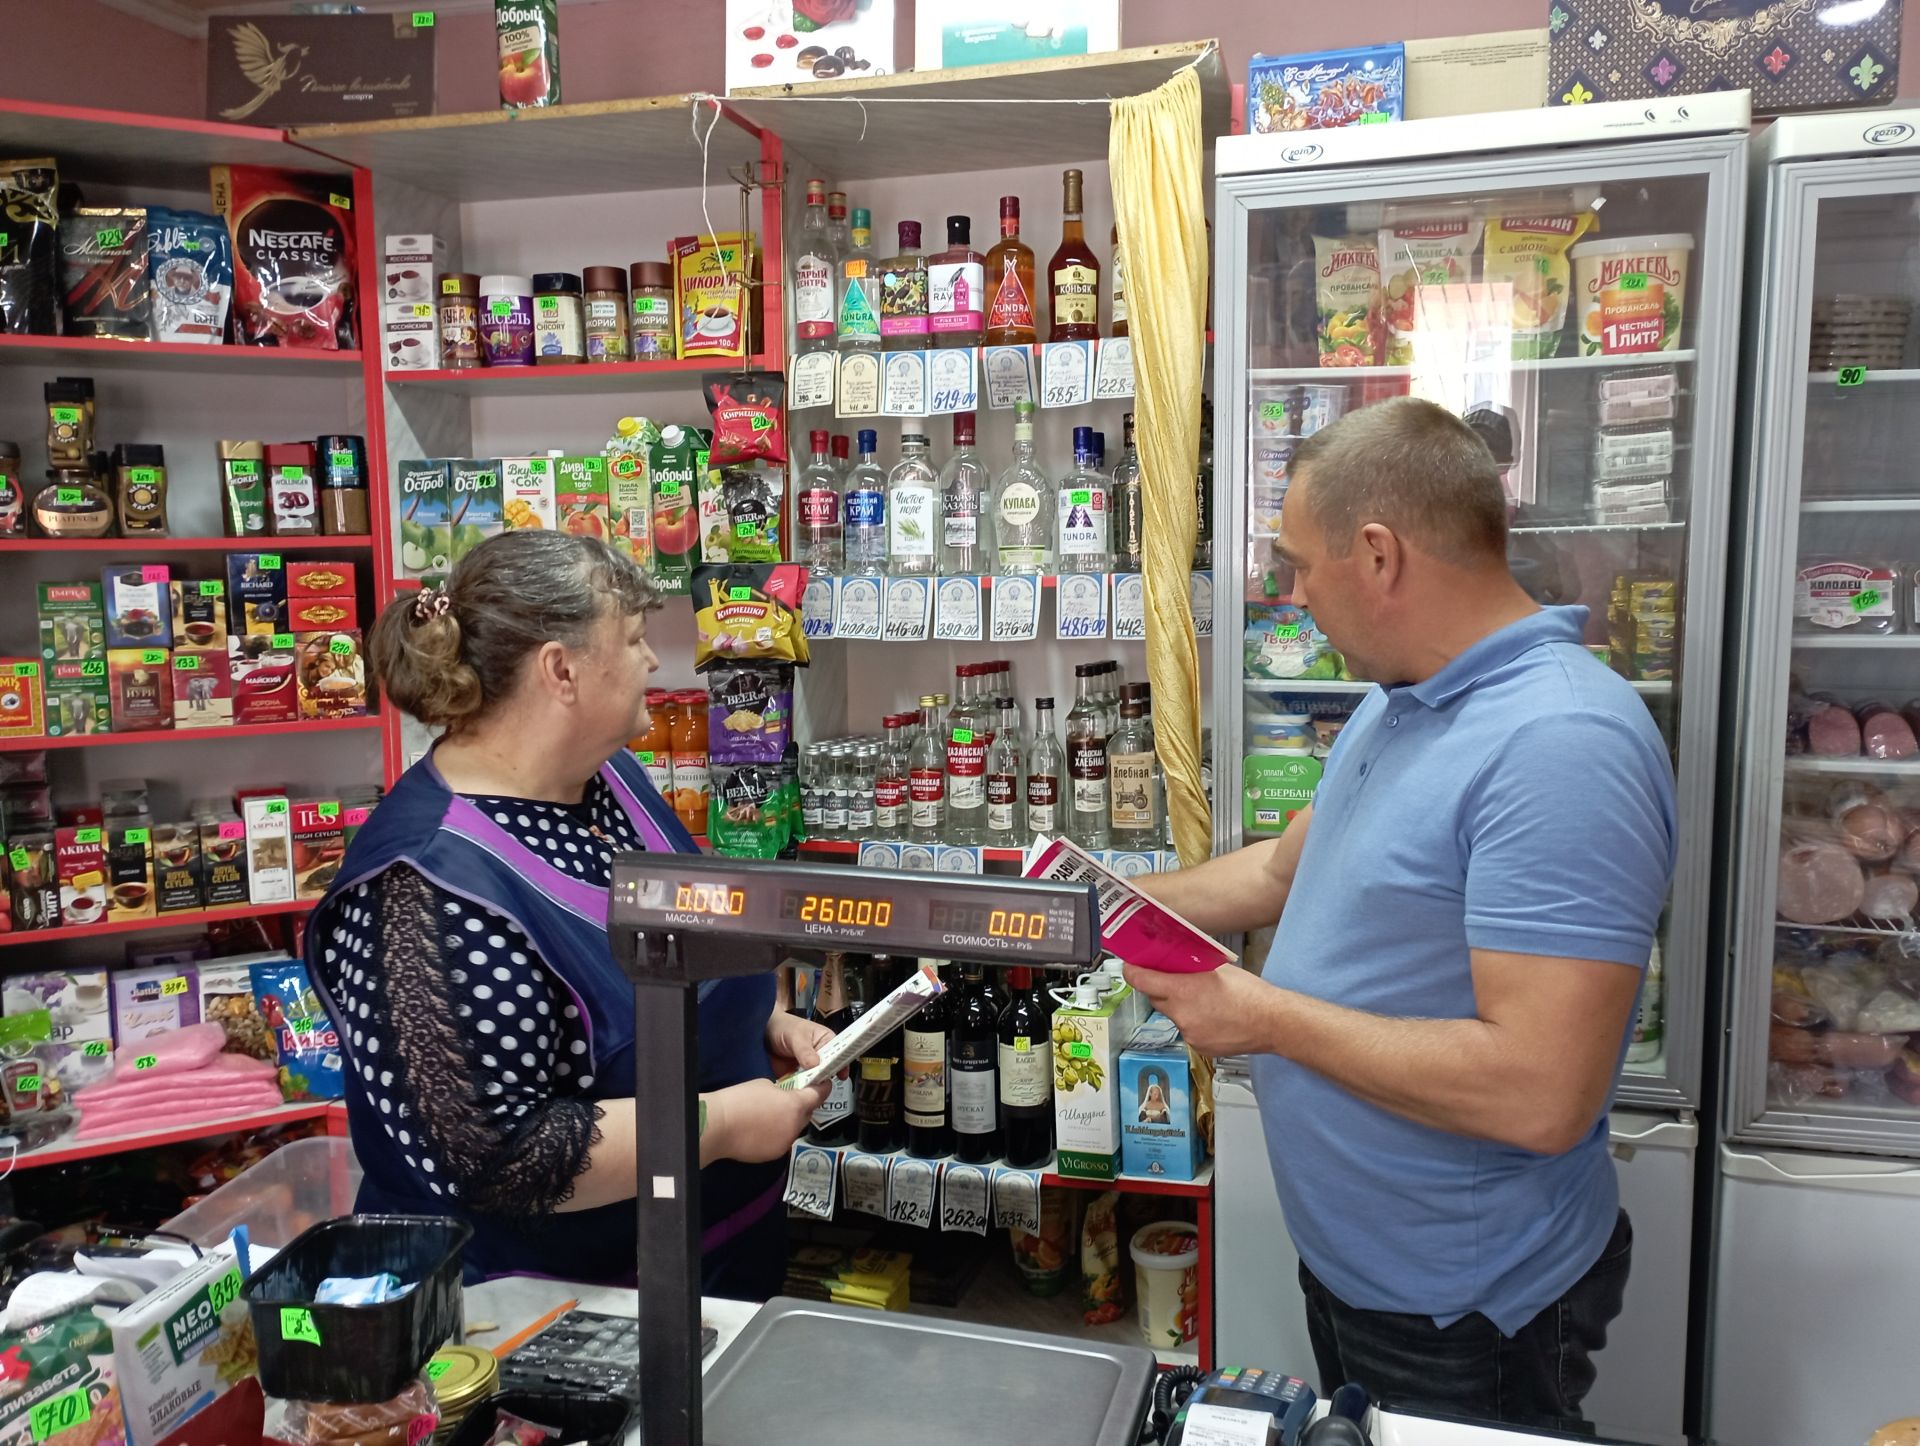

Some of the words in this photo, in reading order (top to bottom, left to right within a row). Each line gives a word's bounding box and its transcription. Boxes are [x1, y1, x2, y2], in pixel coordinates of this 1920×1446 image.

[497, 6, 542, 26] Добрый
[504, 30, 530, 43] 100%
[249, 229, 336, 252] NESCAFÉ
[256, 250, 329, 263] CLASSIC
[681, 246, 696, 255] ГОСТ
[1060, 284, 1093, 294] КОНЬЯК
[993, 304, 1030, 313] TUNDRA
[1605, 303, 1660, 315] ПРОВАНСАЛЬ
[482, 313, 531, 326] КИСЕЛЬ
[1619, 319, 1659, 332] ЧЕСТНЫЙ
[536, 322, 565, 331] CHICORY
[1604, 325, 1617, 349] 1
[1619, 332, 1660, 348] ЛИТР
[1839, 368, 1862, 385] 90
[328, 447, 353, 456] Jardin
[572, 472, 592, 482] САД
[652, 467, 693, 482] Добрый
[403, 475, 444, 494] Остров
[896, 490, 926, 504] Чистое
[944, 494, 975, 502] СТАРАЯ
[1003, 497, 1036, 509] КУПАВА
[1196, 474, 1205, 529] ТАТАРСТАН
[900, 504, 922, 515] поле
[942, 501, 978, 511] КАЗАНЬ
[1063, 532, 1098, 541] TUNDRA
[1810, 580, 1862, 590] ХОЛОДЕЦ
[50, 589, 89, 599] IMPRA
[716, 606, 766, 621] КИРИЕШКИ
[83, 662, 102, 674] 136
[176, 657, 196, 669] 133
[246, 675, 281, 685] МАЙСКИЙ
[1074, 757, 1105, 767] ХЛЕБНАЯ
[1113, 766, 1150, 779] Хлебная
[1263, 769, 1284, 777] ОПЛАТИ
[297, 808, 336, 828] TESS
[1259, 813, 1277, 821] VISA
[294, 833, 312, 841] HIGH
[314, 830, 341, 839] CEYLON
[59, 843, 100, 856] AKBAR
[166, 870, 190, 880] ROYAL
[214, 865, 236, 875] ROYAL
[665, 912, 700, 925] МАССА
[801, 896, 891, 928] 260.00
[804, 923, 833, 935] ЦЕНА
[988, 911, 1045, 940] 0.00
[942, 934, 1009, 949] СТОИМОСТЬ
[1016, 942, 1033, 950] РУБ
[283, 1029, 339, 1051] Кисе
[172, 1300, 212, 1339] NEO
[176, 1318, 214, 1351] botanica
[150, 1380, 202, 1427] ЗЛАКОВЫЕ
